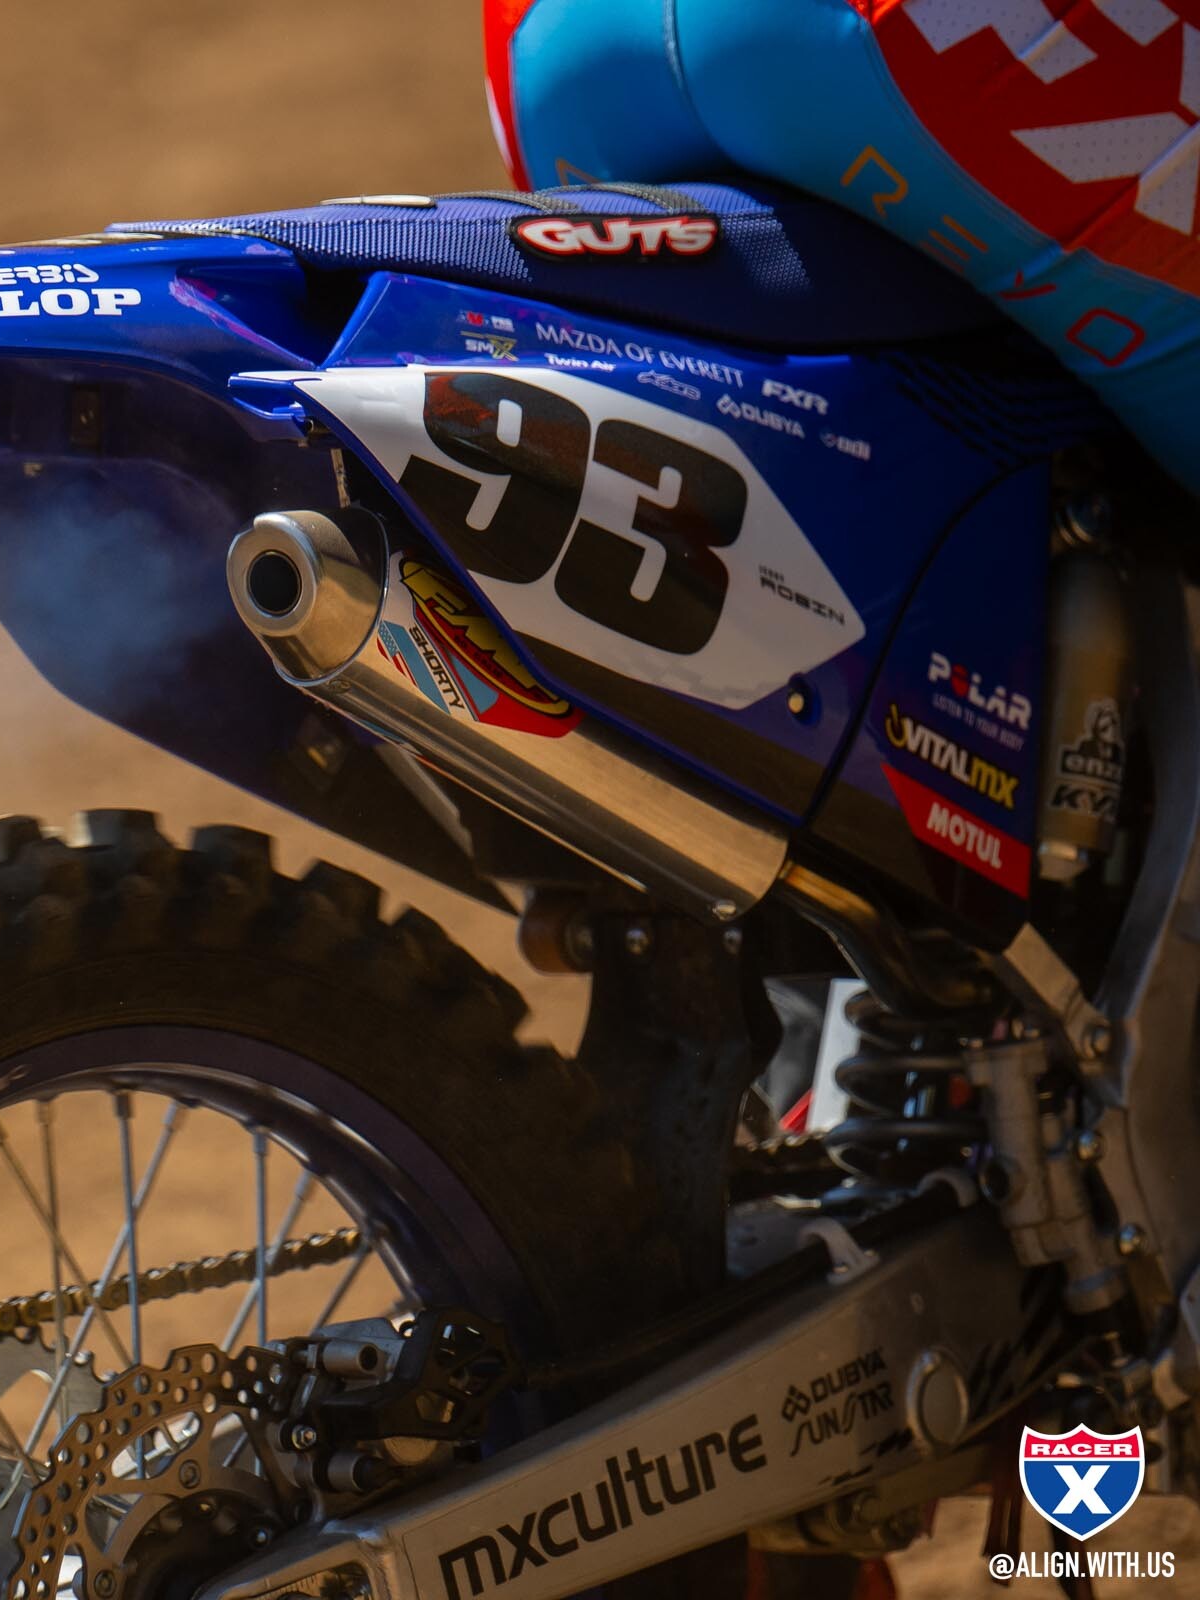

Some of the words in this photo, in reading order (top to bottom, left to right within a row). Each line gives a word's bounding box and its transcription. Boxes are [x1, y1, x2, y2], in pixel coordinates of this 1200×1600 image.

[517, 217, 717, 256] GUTS
[535, 322, 622, 358] MAZDA
[625, 342, 657, 365] OF
[659, 350, 744, 389] EVERETT
[544, 352, 589, 368] Twin
[590, 358, 617, 372] Air
[762, 378, 829, 415] FXR
[397, 371, 748, 656] 93
[408, 625, 464, 709] SHORTY
[927, 651, 1032, 730] POLAR
[926, 801, 1003, 870] MOTUL
[810, 1346, 888, 1403] DUBYA
